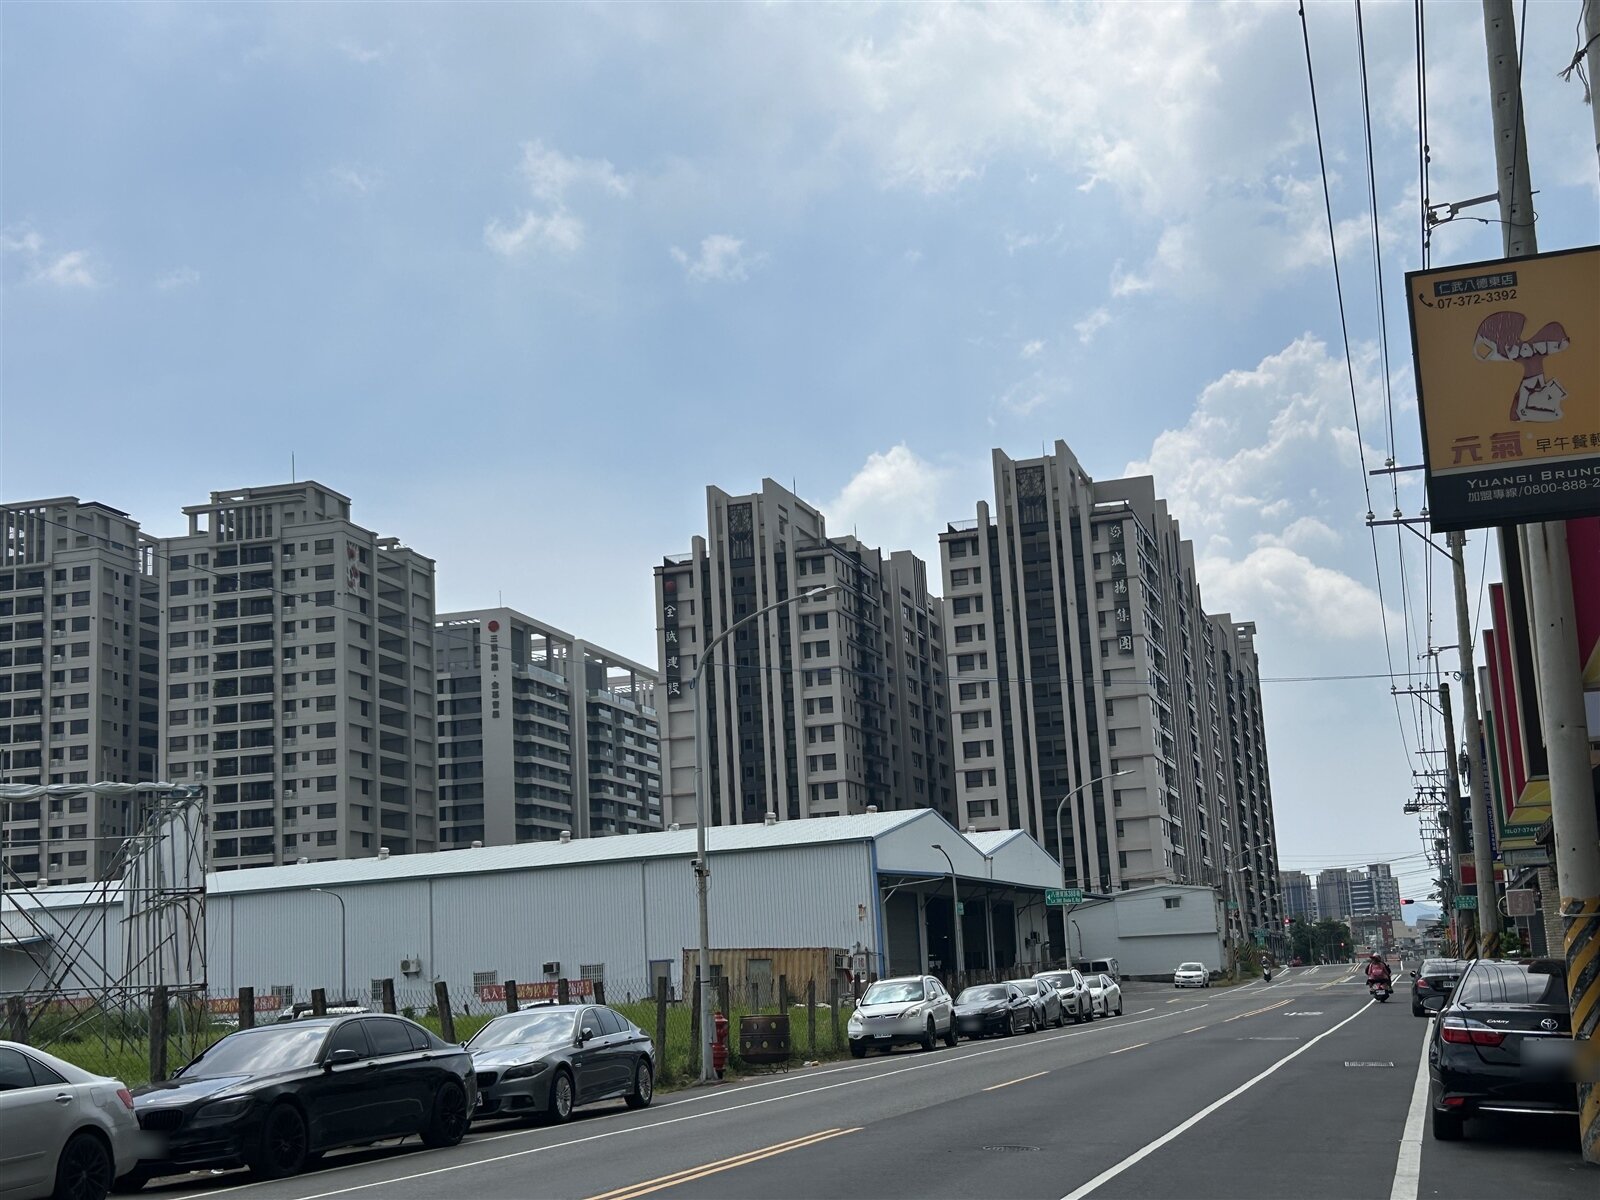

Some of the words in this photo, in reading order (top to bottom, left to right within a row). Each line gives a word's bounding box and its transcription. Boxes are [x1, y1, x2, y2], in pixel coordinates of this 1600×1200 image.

[1437, 289, 1517, 309] 07-372-3392
[1451, 431, 1523, 464] 元氣
[1467, 473, 1533, 489] YUANGI
